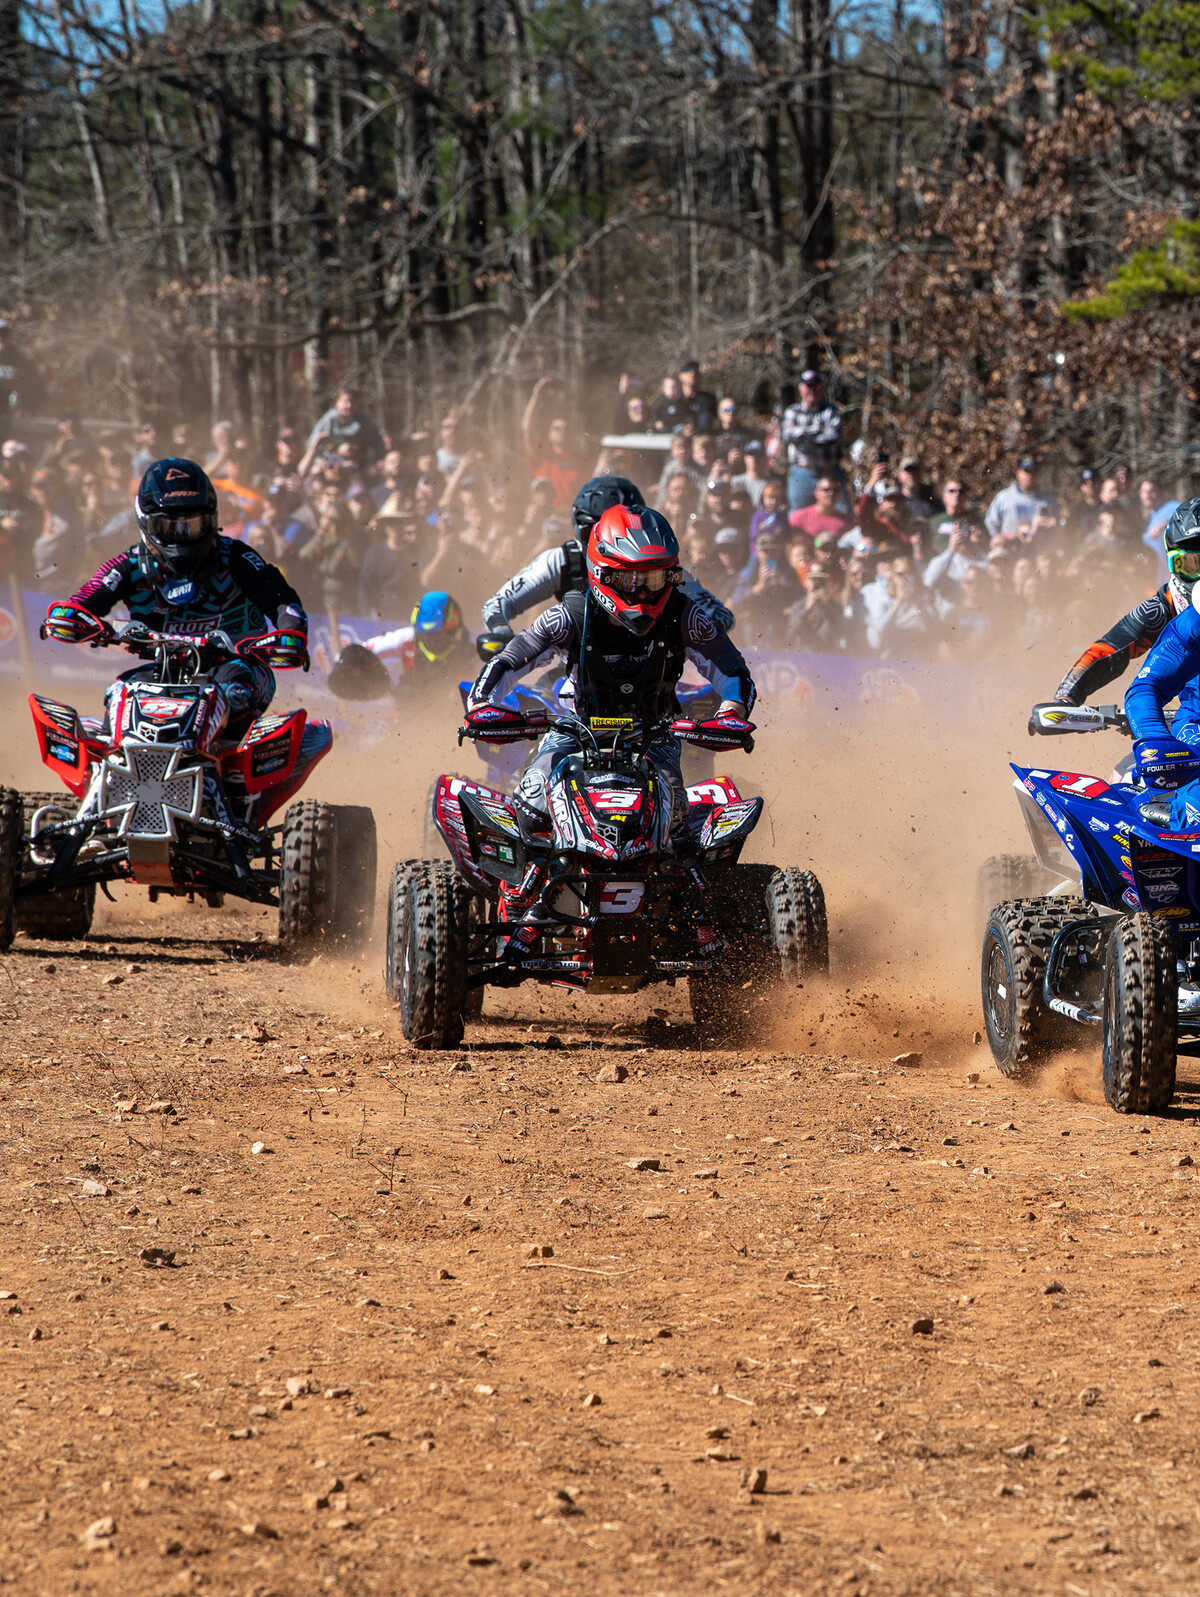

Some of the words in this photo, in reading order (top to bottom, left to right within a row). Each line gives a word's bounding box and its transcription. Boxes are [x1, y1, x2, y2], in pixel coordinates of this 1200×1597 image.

[168, 582, 194, 600] LEATT
[593, 586, 616, 613] 003
[169, 618, 218, 634] KLOTZ
[1146, 763, 1176, 773] FOWLER
[1060, 776, 1100, 793] 1
[595, 792, 639, 808] 3
[600, 882, 645, 914] 3
[1152, 907, 1191, 919] FMF
